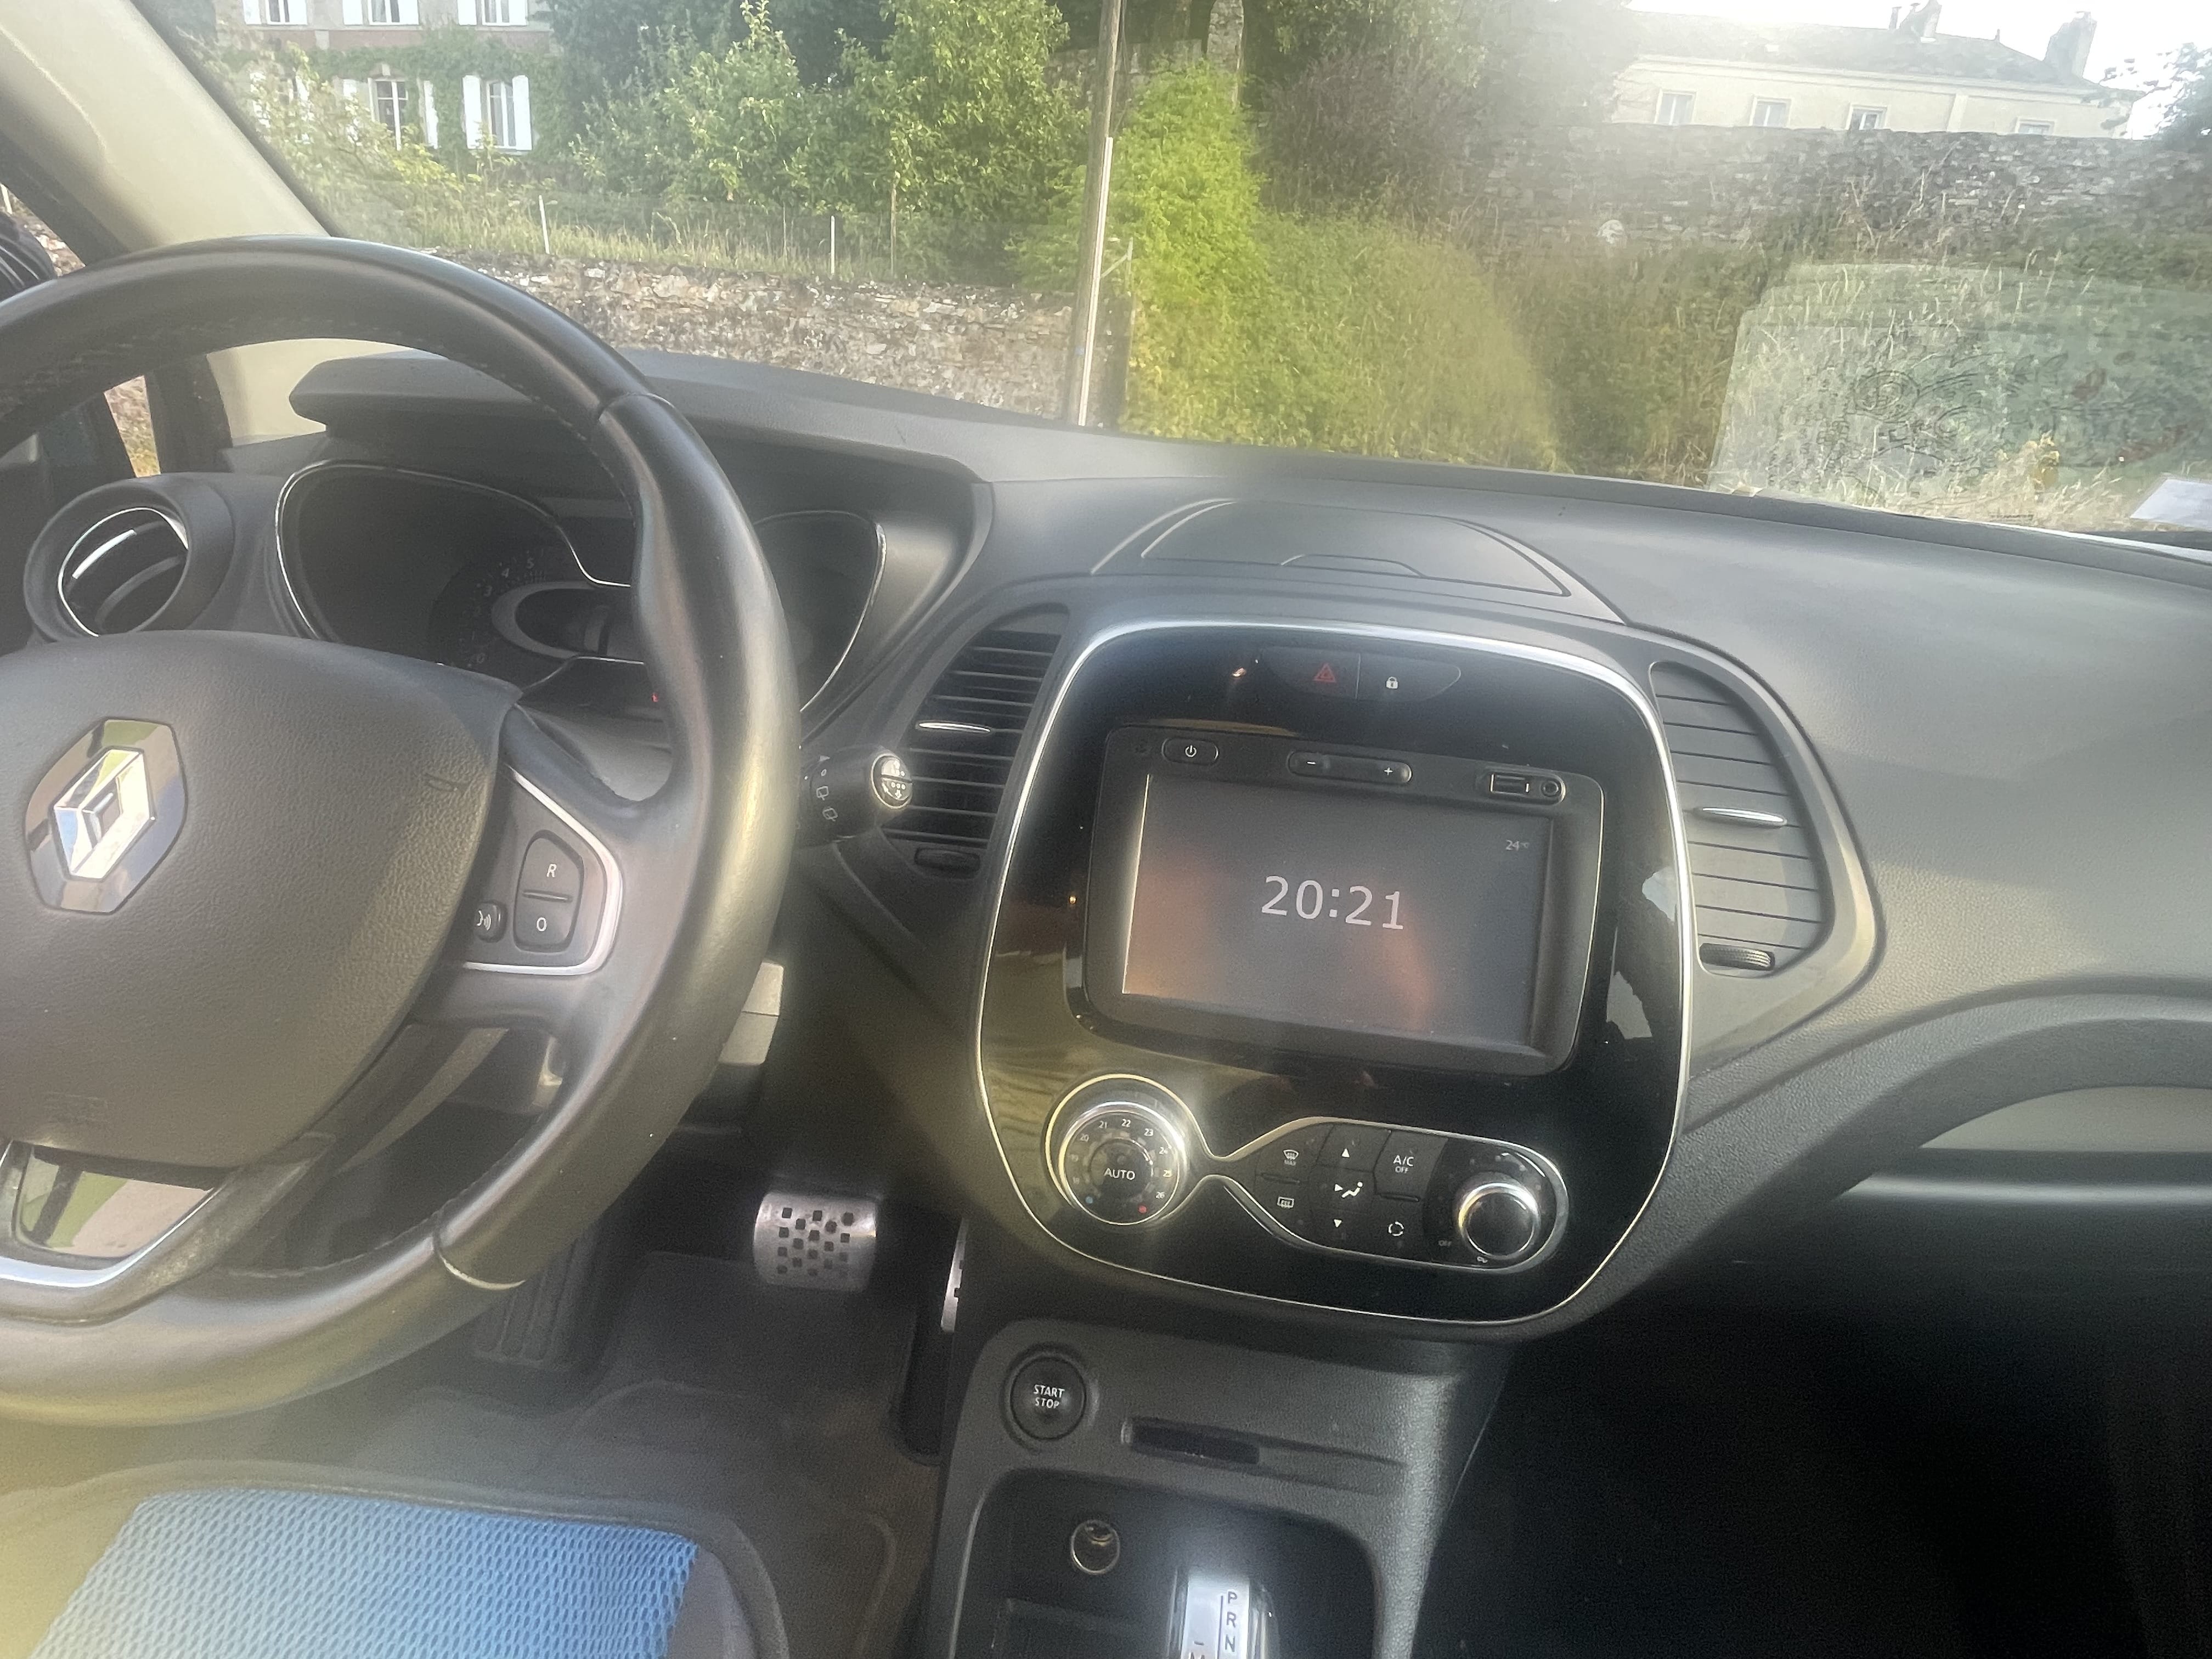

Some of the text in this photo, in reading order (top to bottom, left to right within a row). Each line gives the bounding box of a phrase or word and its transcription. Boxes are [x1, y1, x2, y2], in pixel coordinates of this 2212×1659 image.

[546, 864, 557, 878] R
[1262, 876, 1404, 930] 20:21
[1098, 1120, 1108, 1129] 21
[1121, 1118, 1131, 1128] 22
[1080, 1133, 1090, 1142] 20
[1144, 1128, 1154, 1136] 23
[1393, 1155, 1414, 1167] A/C
[1104, 1167, 1136, 1181] AUTO
[1395, 1166, 1409, 1174] OFF
[1033, 1384, 1065, 1398] START
[1035, 1397, 1060, 1409] STOP
[1227, 1591, 1238, 1605] P
[1226, 1611, 1237, 1628] R
[1224, 1634, 1235, 1653] N
